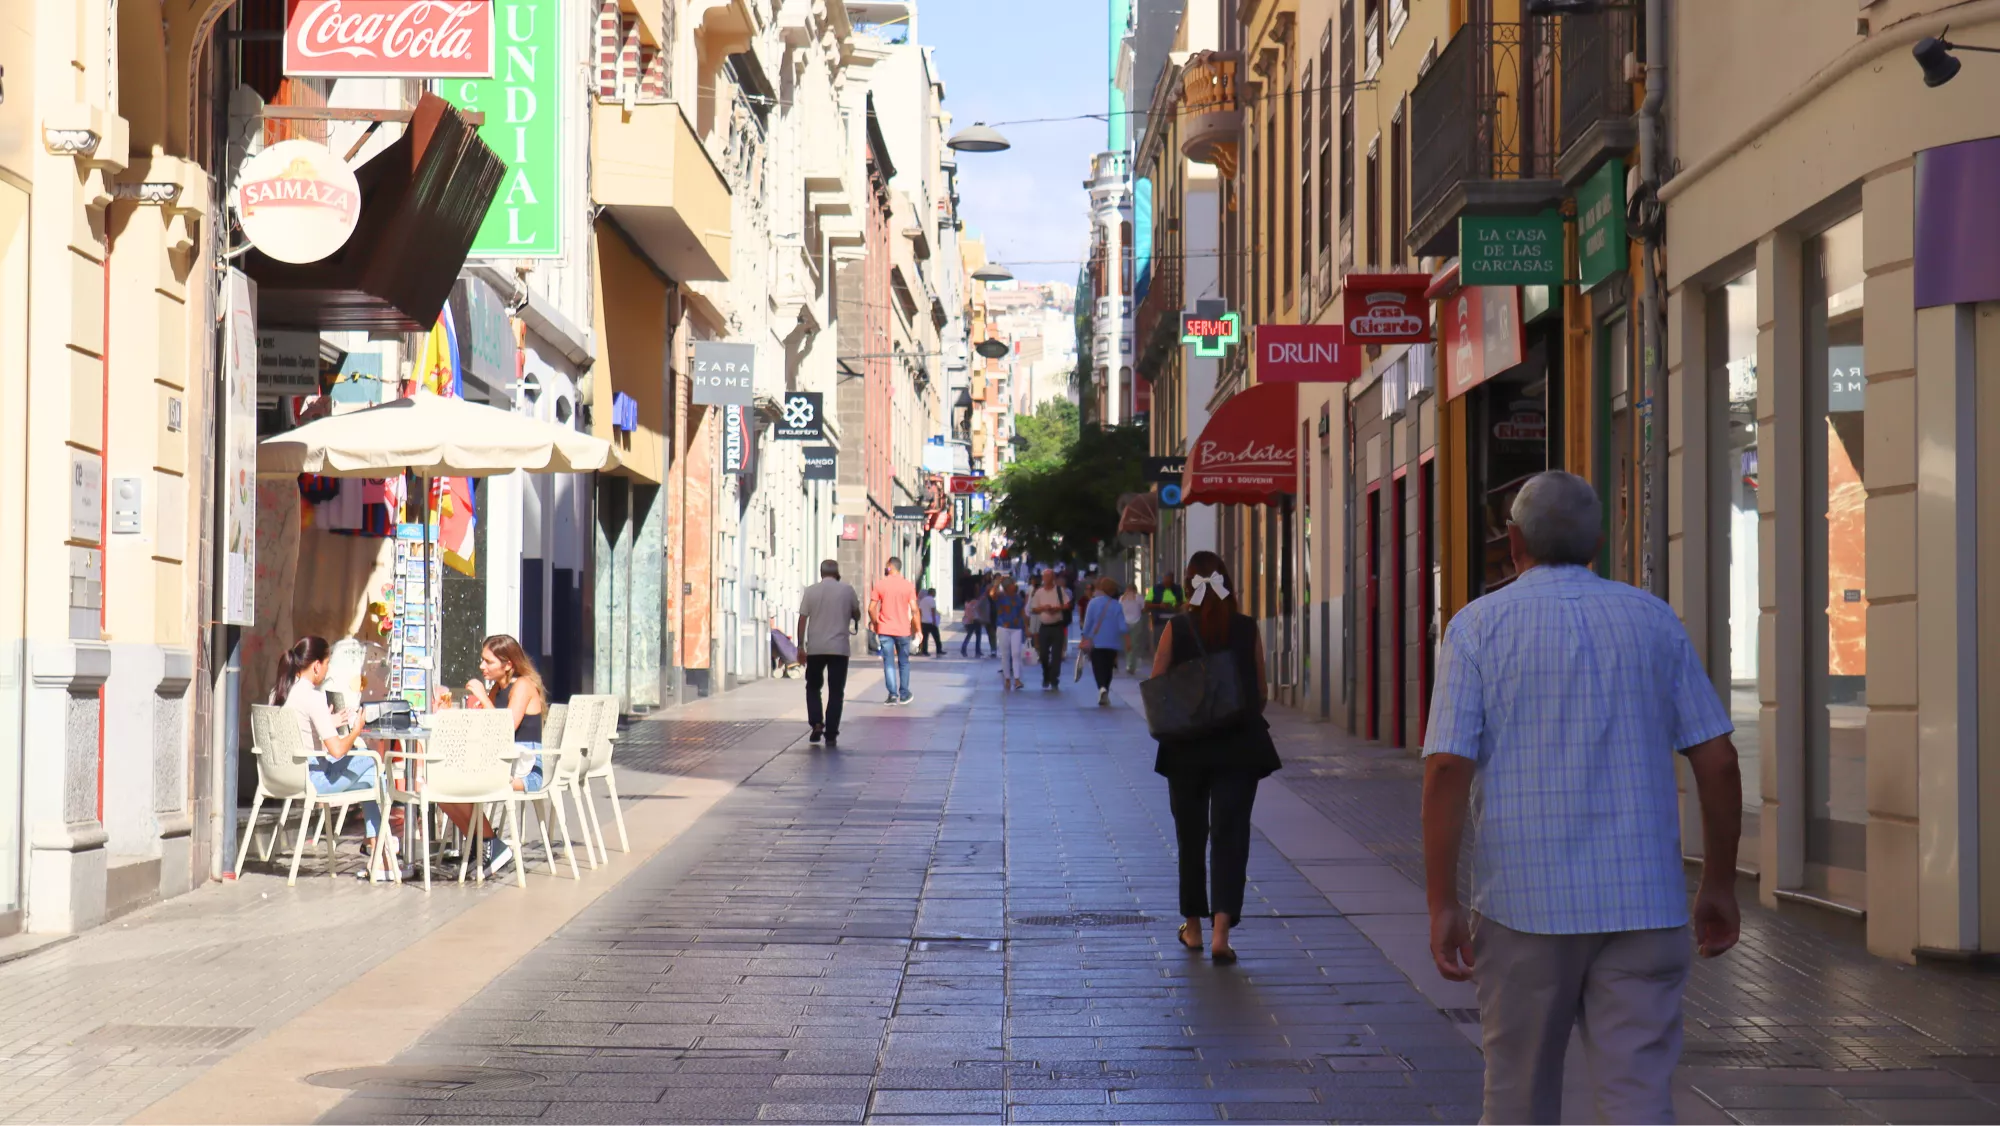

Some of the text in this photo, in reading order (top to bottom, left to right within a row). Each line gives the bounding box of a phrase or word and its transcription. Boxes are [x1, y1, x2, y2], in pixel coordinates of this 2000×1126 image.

[297, 0, 484, 58] Coca-Cola
[245, 180, 349, 210] SAIMAZA
[1478, 229, 1547, 242] LA CASA
[1483, 245, 1541, 257] DE LAS
[1472, 260, 1553, 272] CARCASAS
[1187, 320, 1232, 336] SERVICI
[1355, 319, 1420, 334] Ricardo
[1268, 343, 1339, 364] DRUNI
[697, 361, 750, 373] ZARA
[696, 376, 750, 388] HOME
[727, 404, 741, 470] PRIMOR
[778, 428, 819, 436] encuentro
